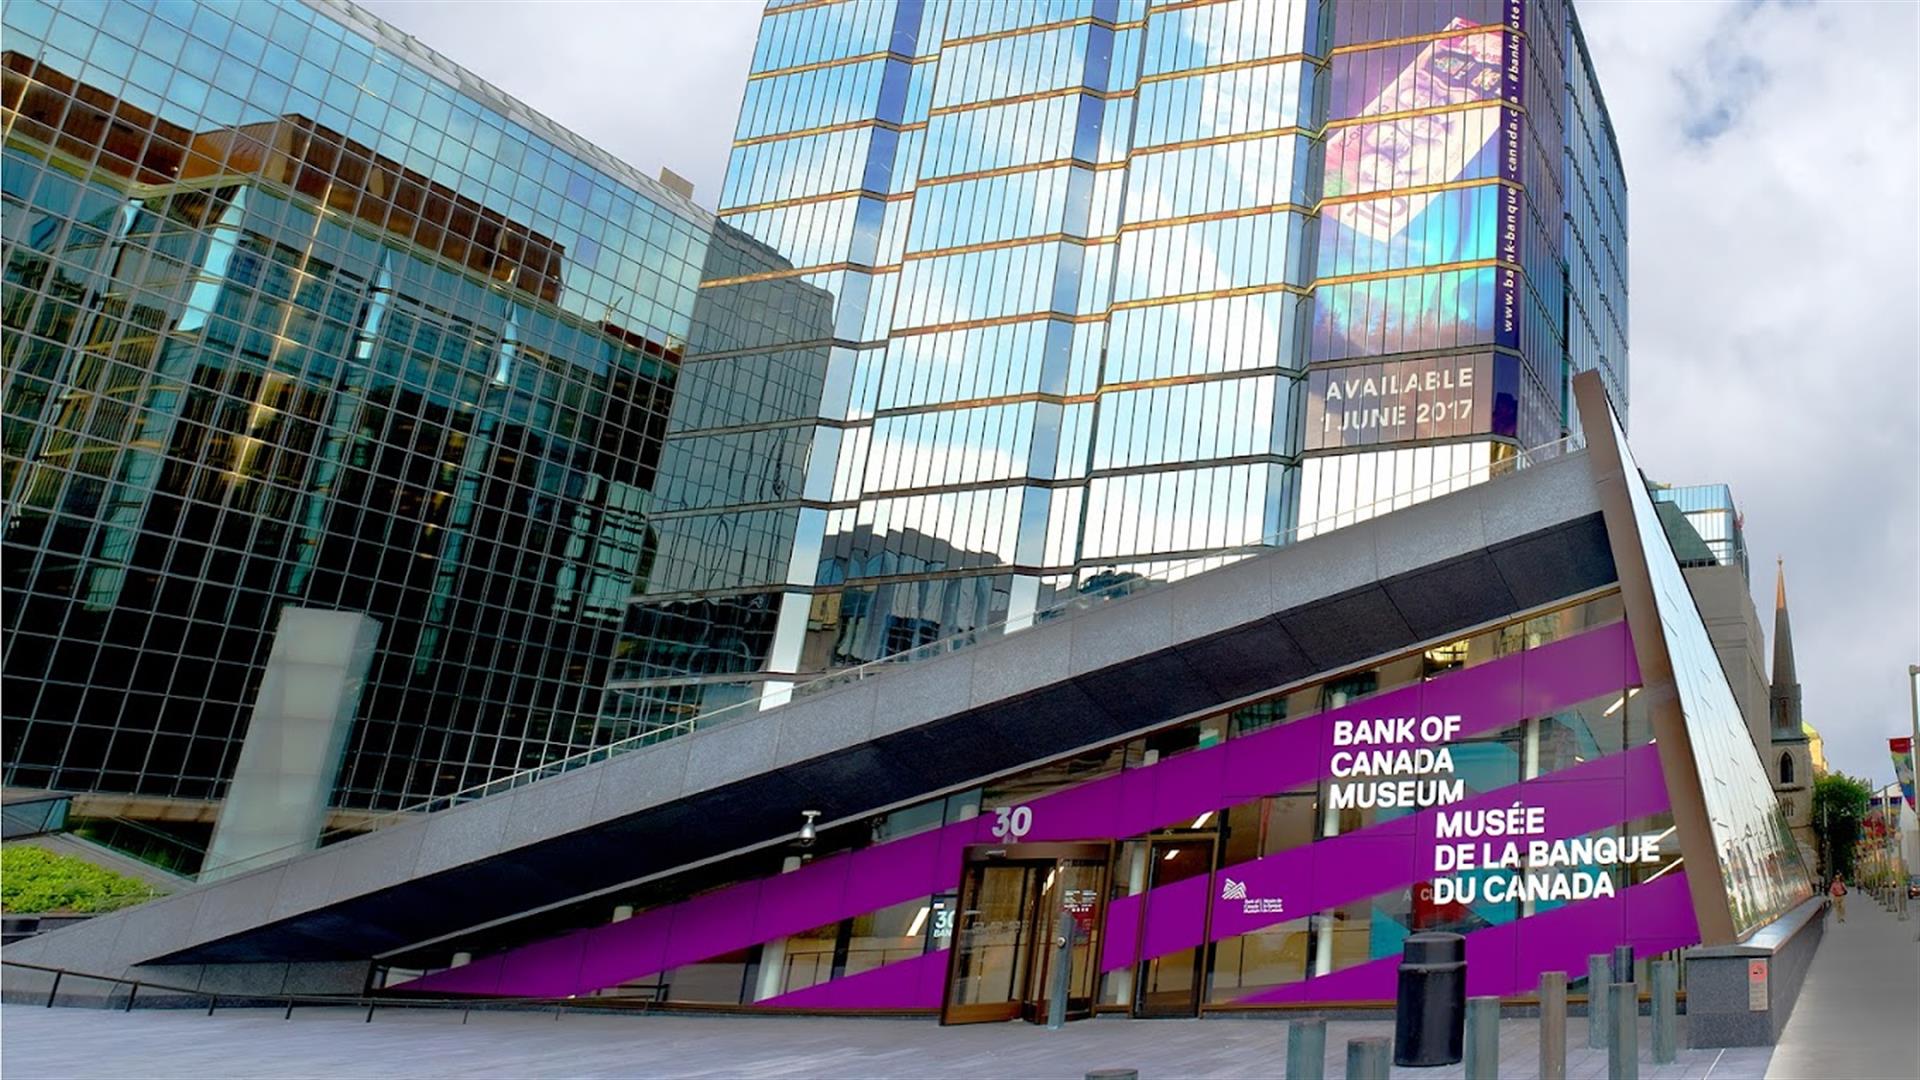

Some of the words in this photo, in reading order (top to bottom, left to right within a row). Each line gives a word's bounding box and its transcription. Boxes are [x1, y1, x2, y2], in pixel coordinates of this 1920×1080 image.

[1326, 368, 1473, 401] AVAILABLE
[1320, 412, 1330, 433] 1
[1337, 405, 1407, 432] JUNE
[1416, 398, 1473, 424] 2017
[1333, 717, 1416, 746] BANK
[1420, 715, 1462, 743] OF
[1330, 747, 1455, 778] CANADA
[1329, 779, 1465, 809] MUSEUM
[992, 805, 1032, 838] 30
[1436, 800, 1545, 838] MUSÉE
[1434, 843, 1476, 871] DE
[1483, 841, 1521, 870] LA
[1528, 835, 1661, 868] BANQUE
[1433, 876, 1476, 905] DU
[1483, 870, 1616, 903] CANADA
